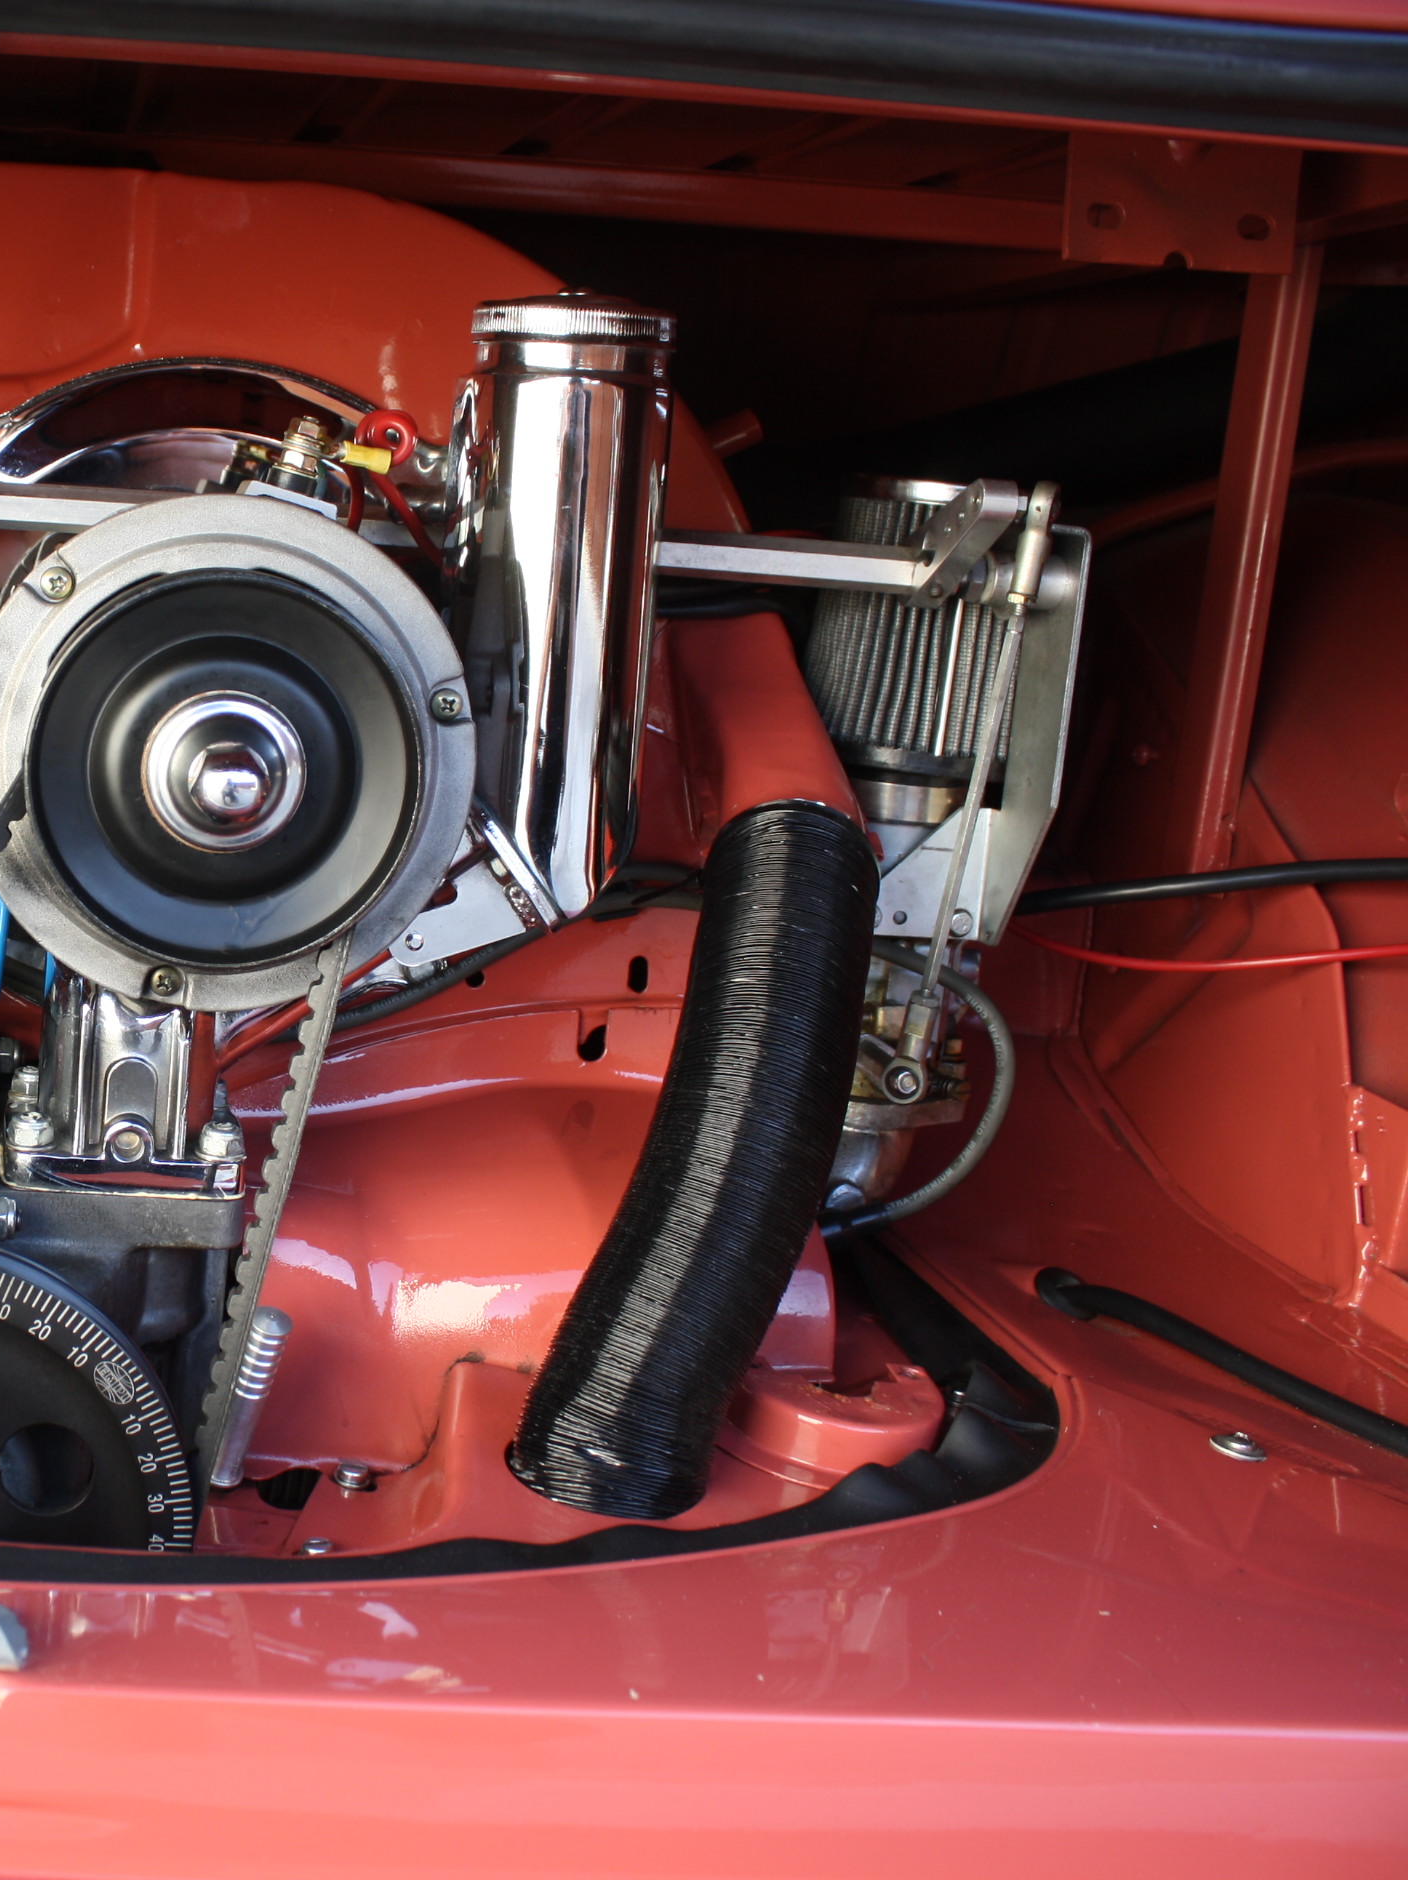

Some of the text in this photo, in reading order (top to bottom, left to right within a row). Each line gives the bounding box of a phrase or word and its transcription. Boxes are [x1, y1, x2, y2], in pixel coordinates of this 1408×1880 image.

[959, 1140, 977, 1162] 7MM
[28, 1319, 52, 1340] 20
[66, 1346, 88, 1368] 10
[96, 1363, 132, 1402] EMPI
[121, 1414, 142, 1434] 10
[137, 1453, 157, 1473] 20
[147, 1493, 165, 1513] 30
[148, 1534, 165, 1553] 40
